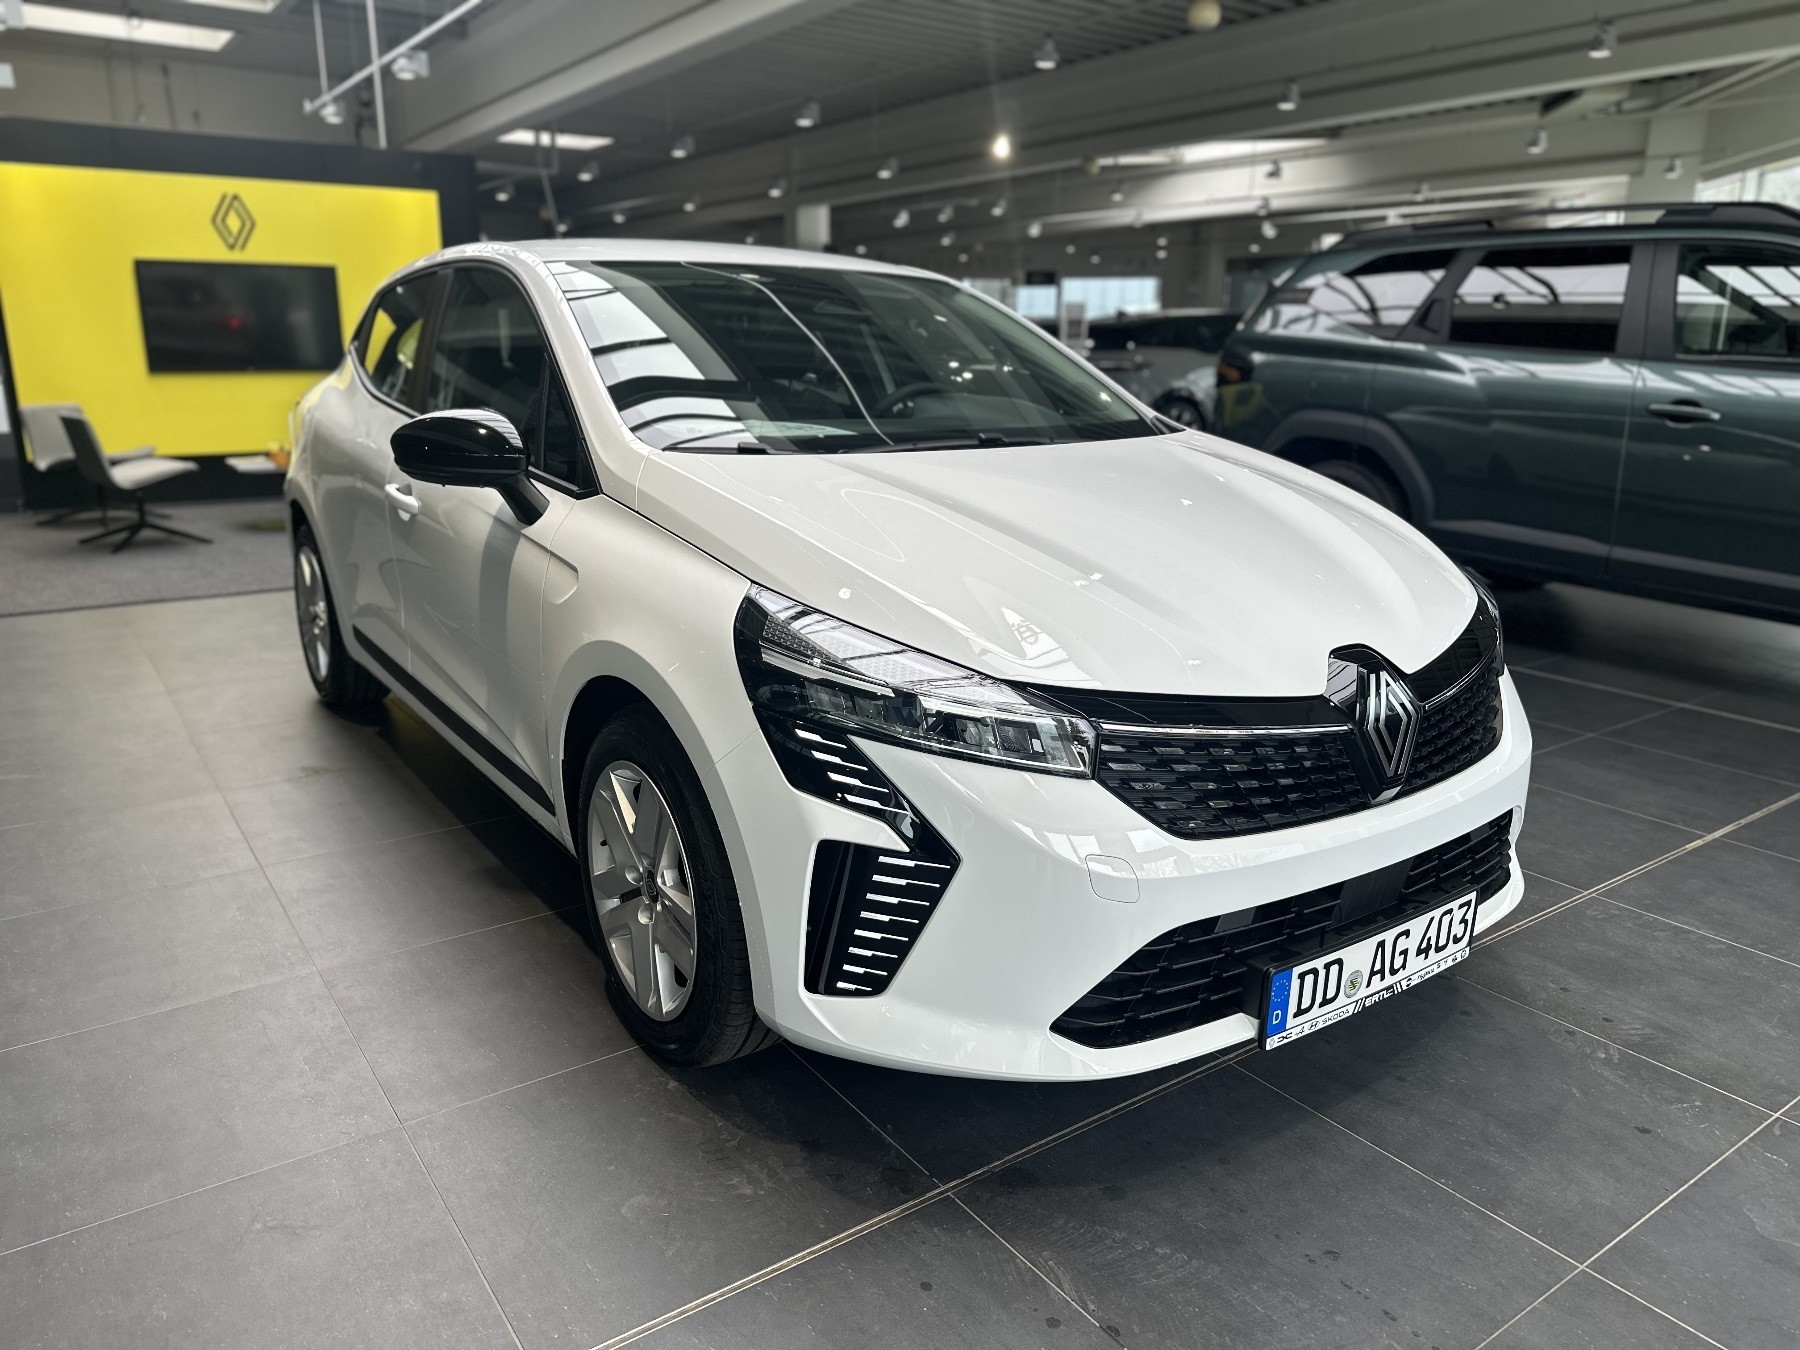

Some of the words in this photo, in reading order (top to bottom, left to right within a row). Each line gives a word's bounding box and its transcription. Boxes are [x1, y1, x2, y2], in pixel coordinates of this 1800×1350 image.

[1293, 957, 1344, 1019] DD
[1366, 928, 1411, 989] AG
[1416, 899, 1472, 961] 403
[1272, 1009, 1282, 1025] D
